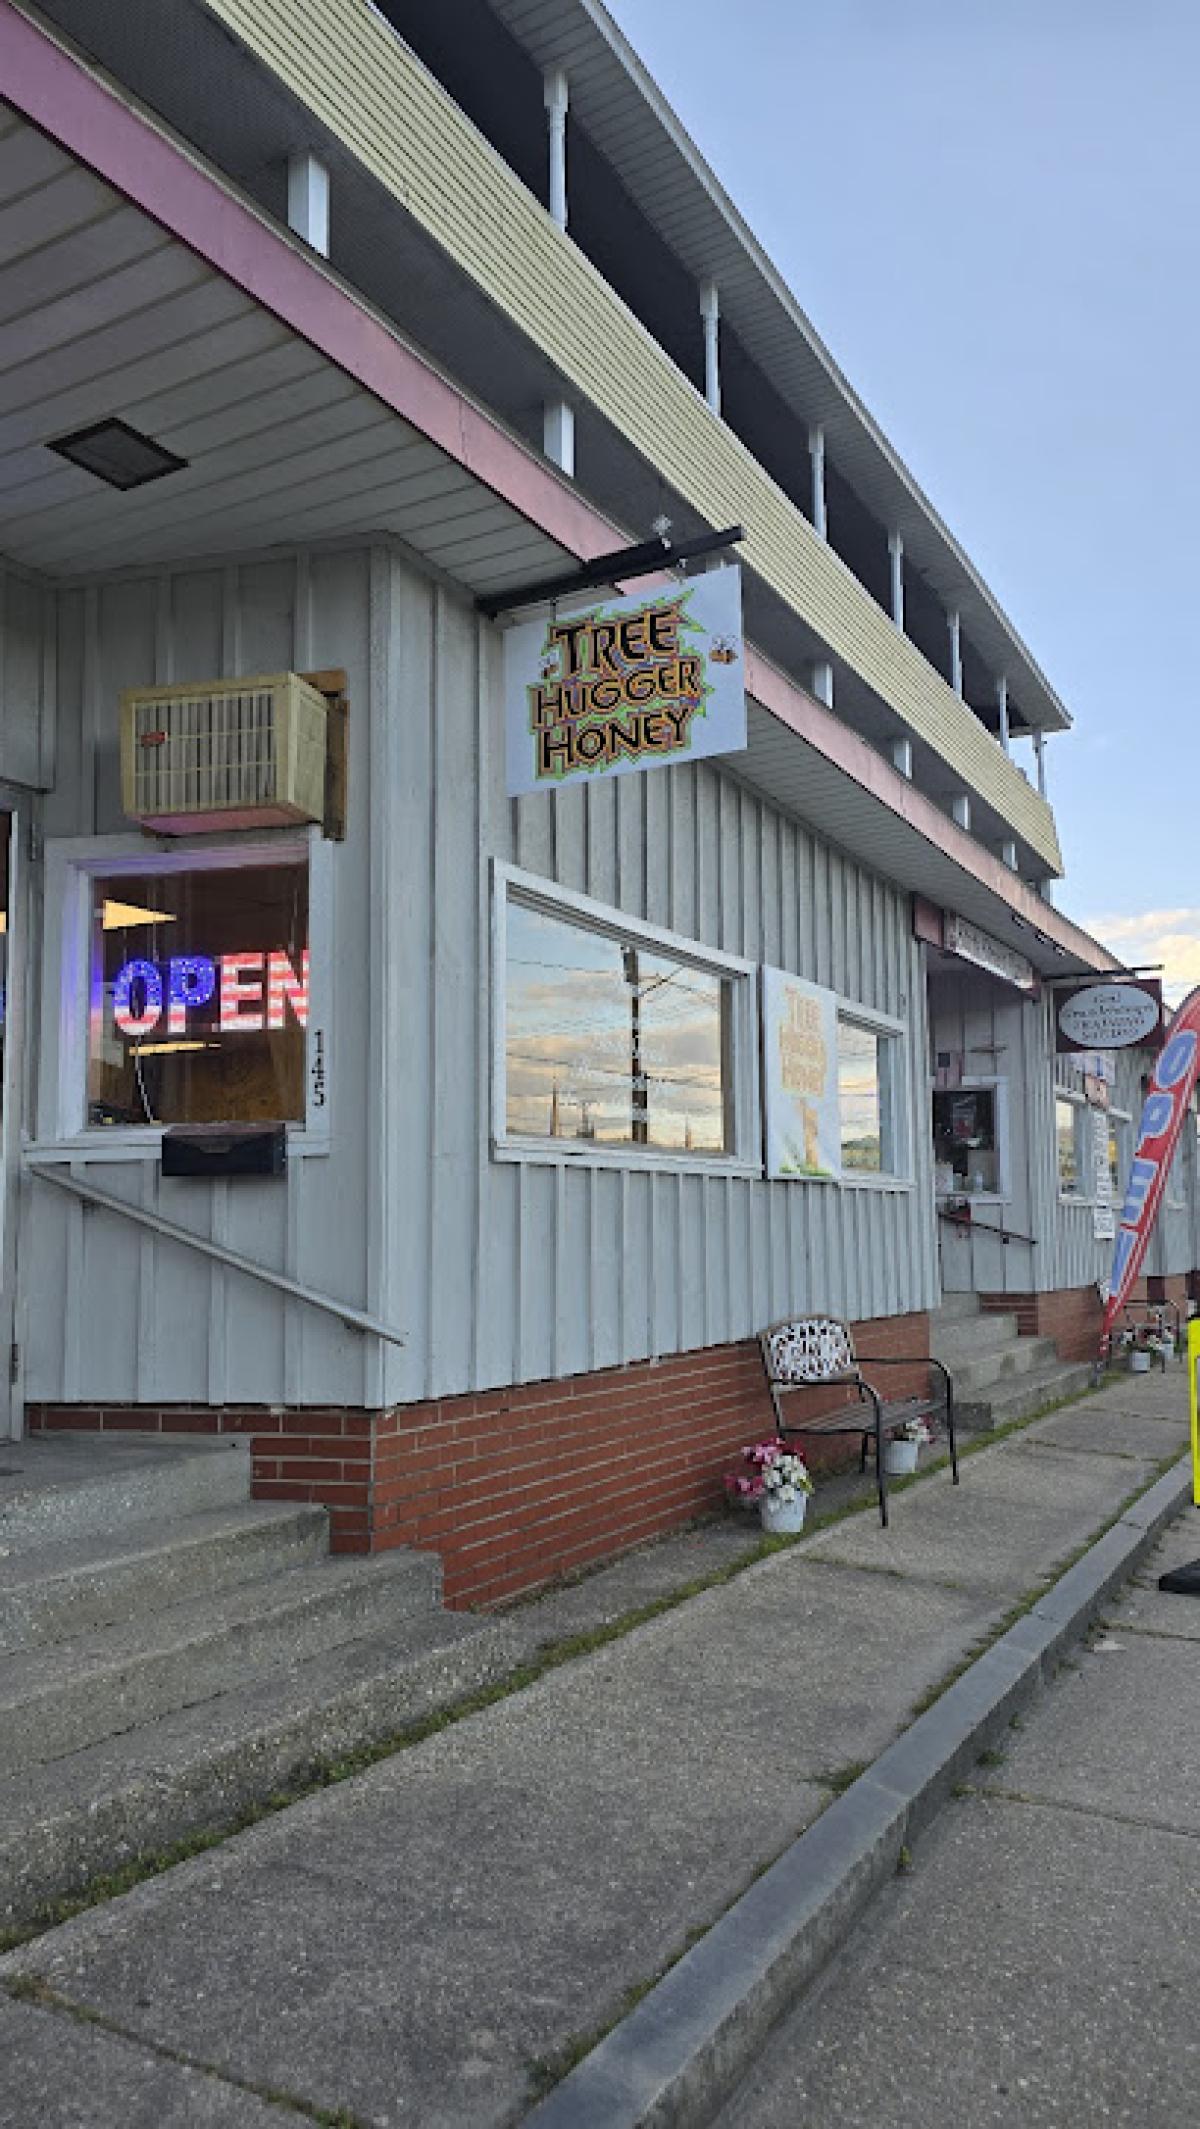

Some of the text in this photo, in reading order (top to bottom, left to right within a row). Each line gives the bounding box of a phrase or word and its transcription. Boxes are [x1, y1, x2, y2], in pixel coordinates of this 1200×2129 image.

[550, 604, 682, 675] TREE
[533, 658, 699, 727] HUGGER
[538, 706, 690, 775] HONEY
[114, 949, 309, 1035] OPEN
[311, 1030, 325, 1106] 145
